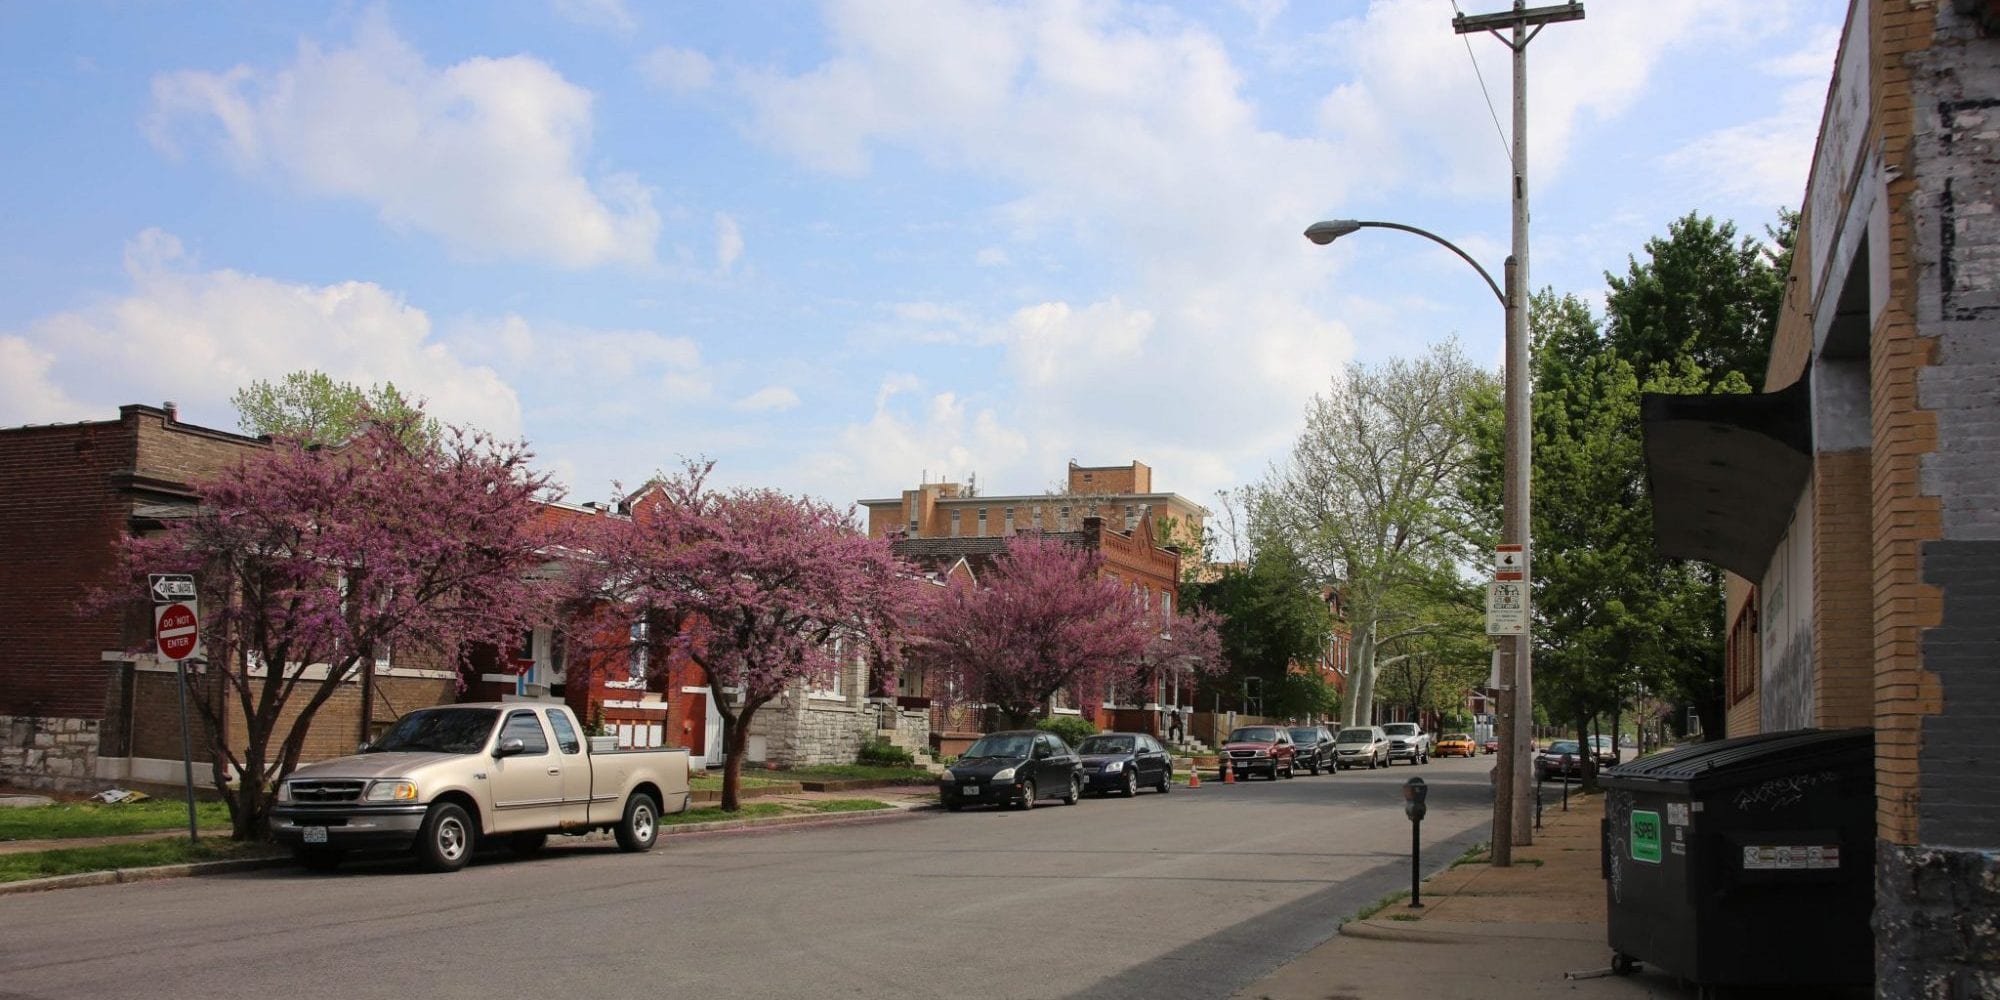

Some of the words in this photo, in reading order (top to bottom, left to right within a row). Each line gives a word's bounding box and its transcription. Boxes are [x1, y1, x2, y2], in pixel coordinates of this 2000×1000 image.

[159, 583, 175, 593] ONE
[177, 583, 191, 593] WAY
[163, 618, 173, 628] DO
[176, 616, 189, 625] NOT
[167, 638, 189, 648] ENTER
